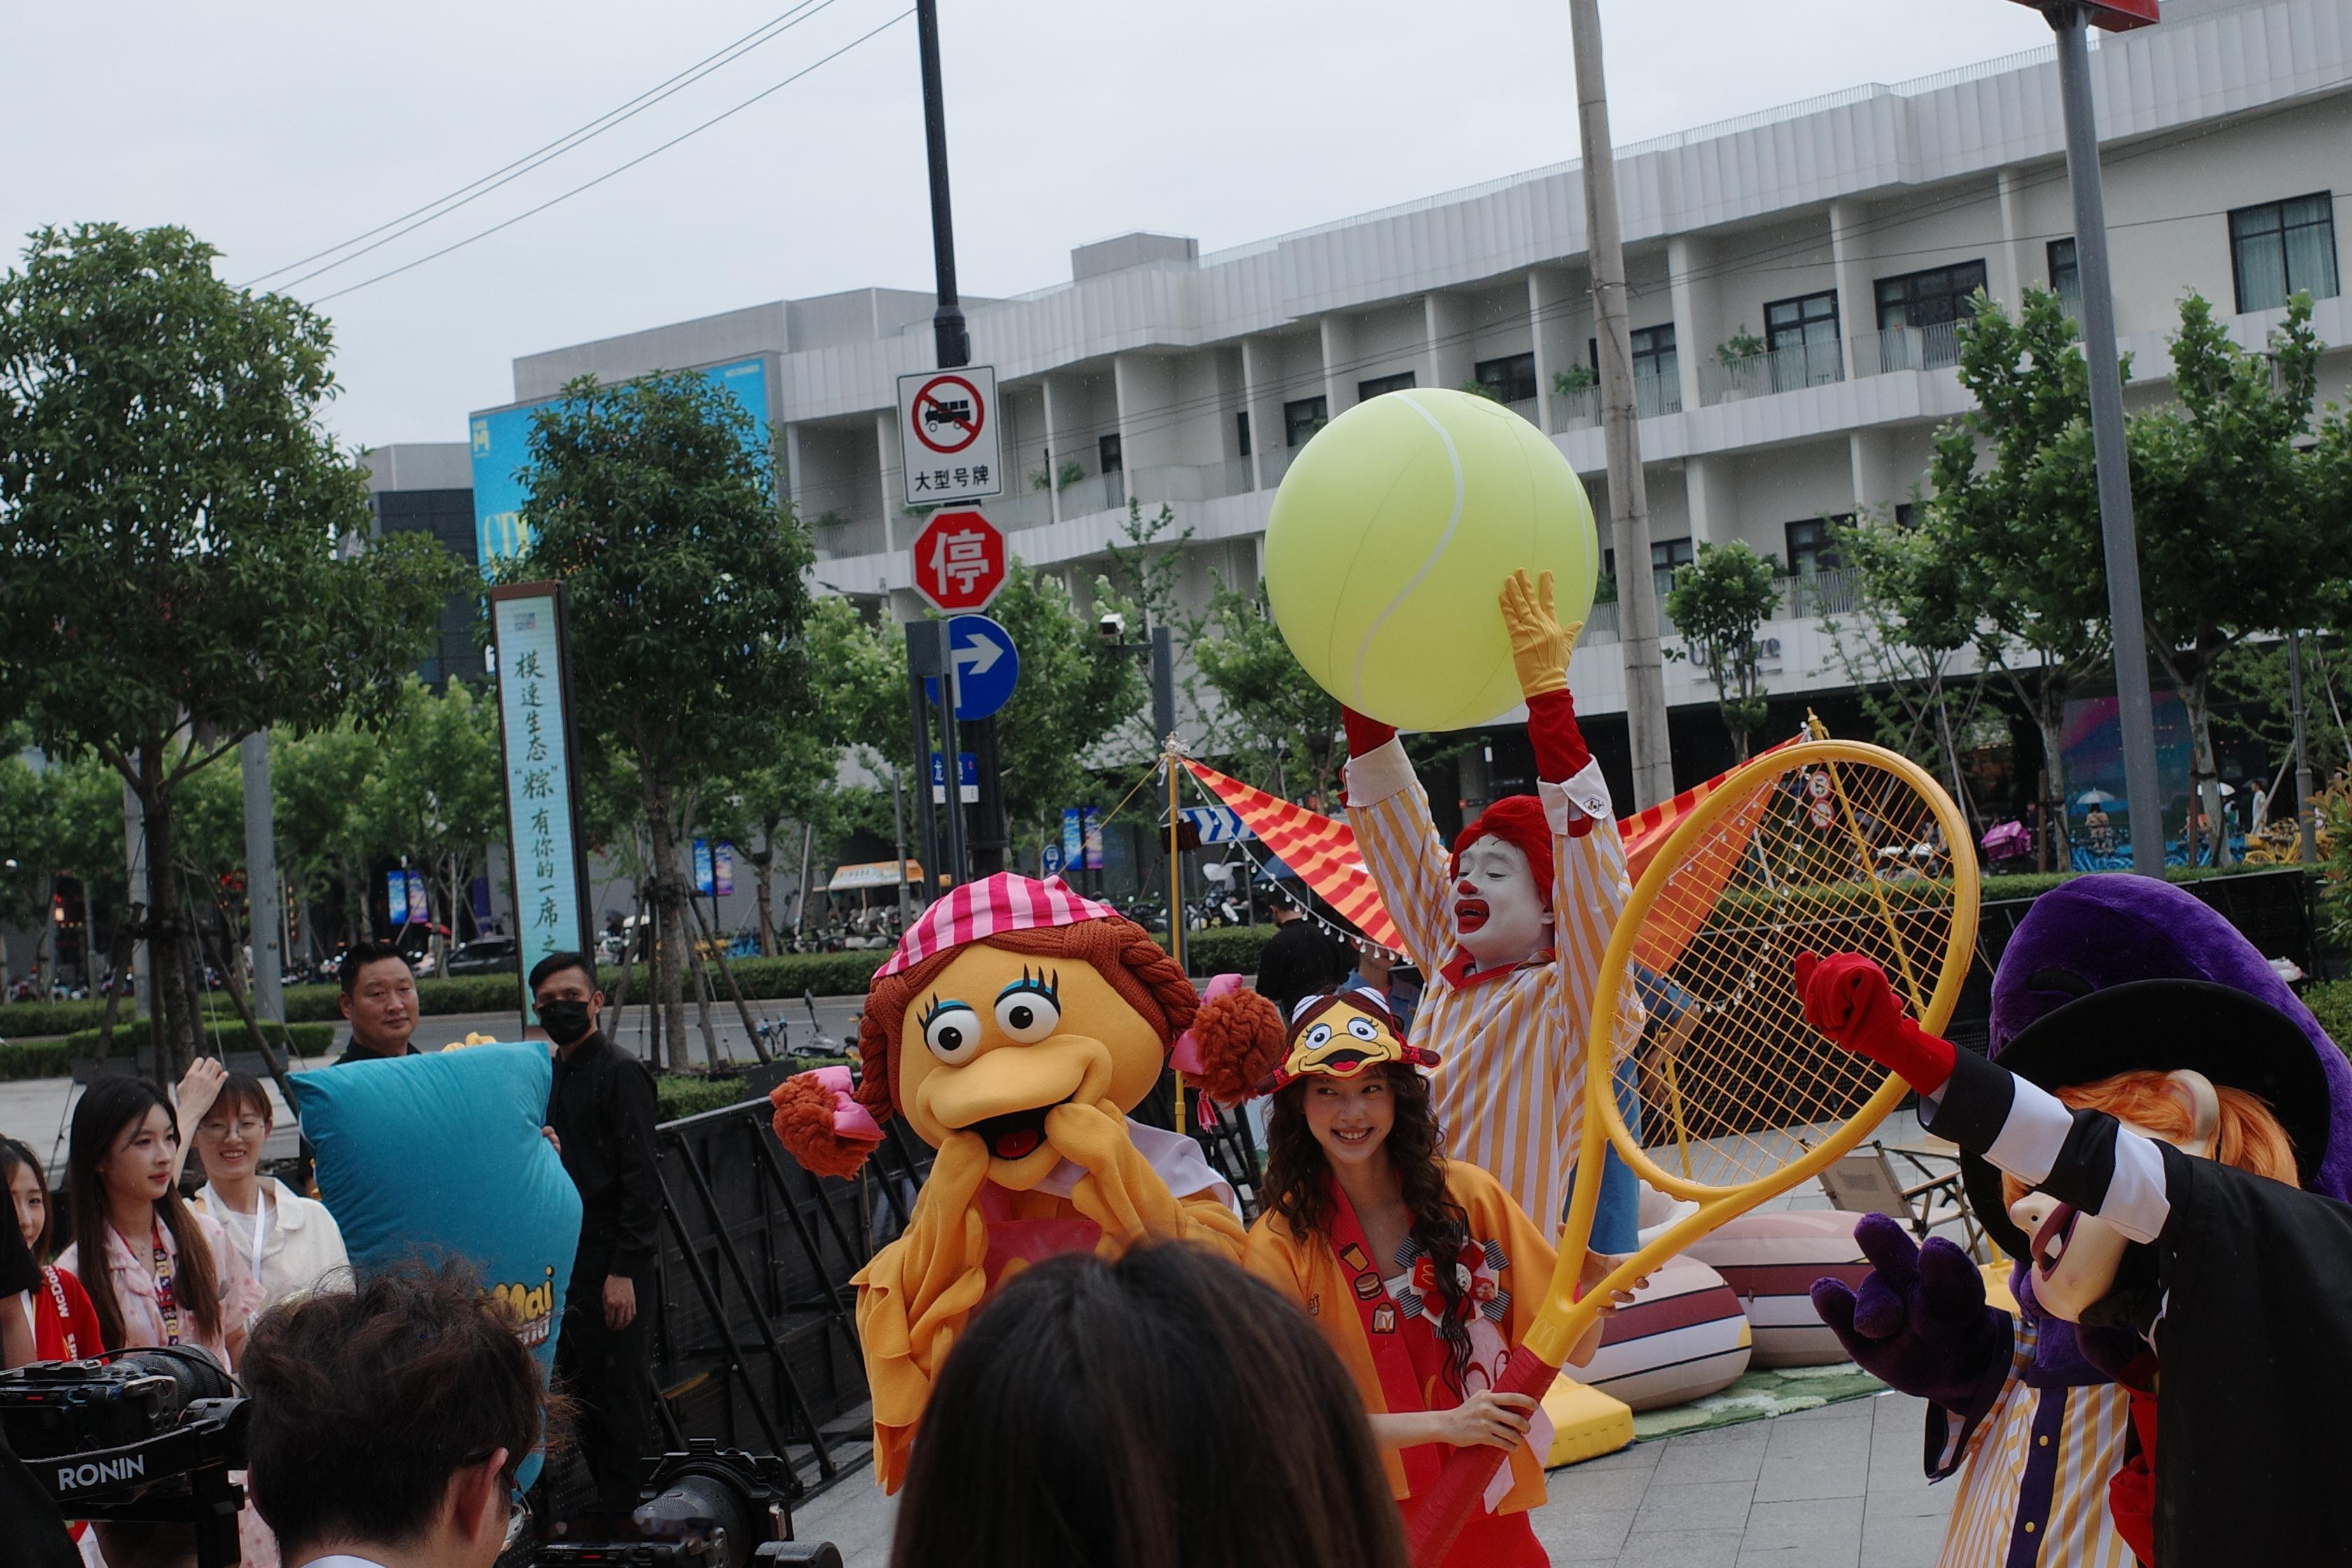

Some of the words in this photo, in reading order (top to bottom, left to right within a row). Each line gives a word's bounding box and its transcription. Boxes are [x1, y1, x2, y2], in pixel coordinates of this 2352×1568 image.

[915, 464, 990, 491] 大型号牌
[929, 528, 988, 595] 停
[57, 1454, 145, 1491] RONIN
